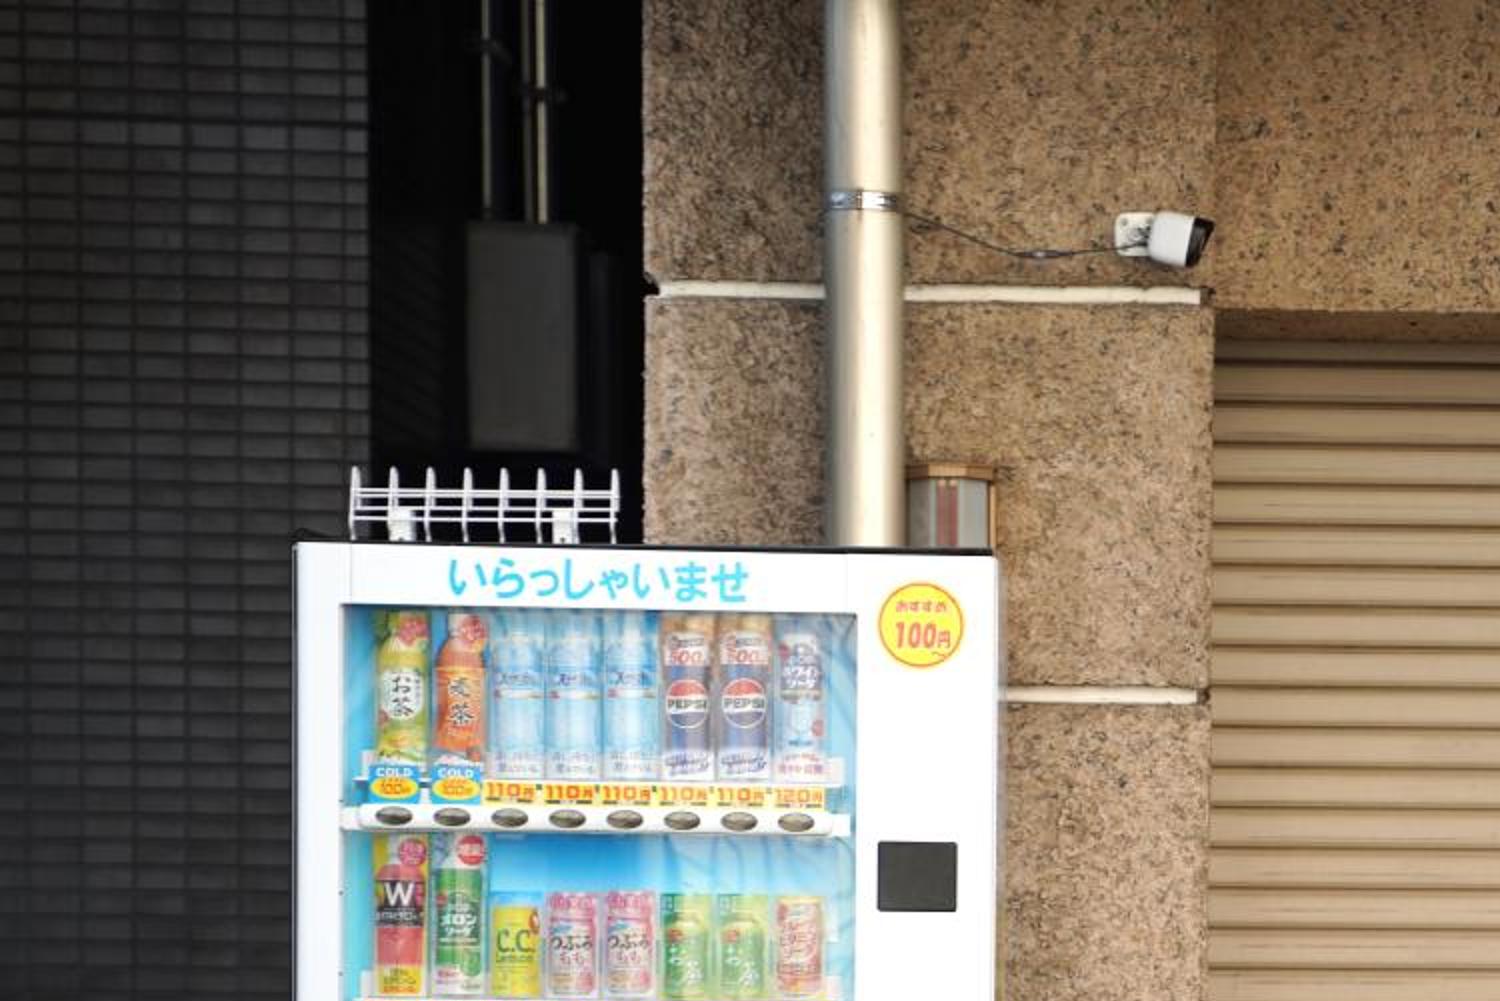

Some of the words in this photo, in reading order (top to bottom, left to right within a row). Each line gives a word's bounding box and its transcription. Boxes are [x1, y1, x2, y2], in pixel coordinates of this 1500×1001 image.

[449, 557, 749, 602] いらっしゃいませ
[896, 600, 946, 613] おすすめ
[667, 699, 707, 709] PEPSI
[724, 699, 764, 709] PEPSI
[375, 767, 413, 777] COLD
[437, 767, 474, 778] COLD
[485, 783, 535, 798] 110円
[546, 785, 593, 799] 110円
[602, 786, 651, 801] 110円
[659, 786, 707, 801] 110円
[718, 787, 765, 801] 110円
[384, 882, 415, 907] W
